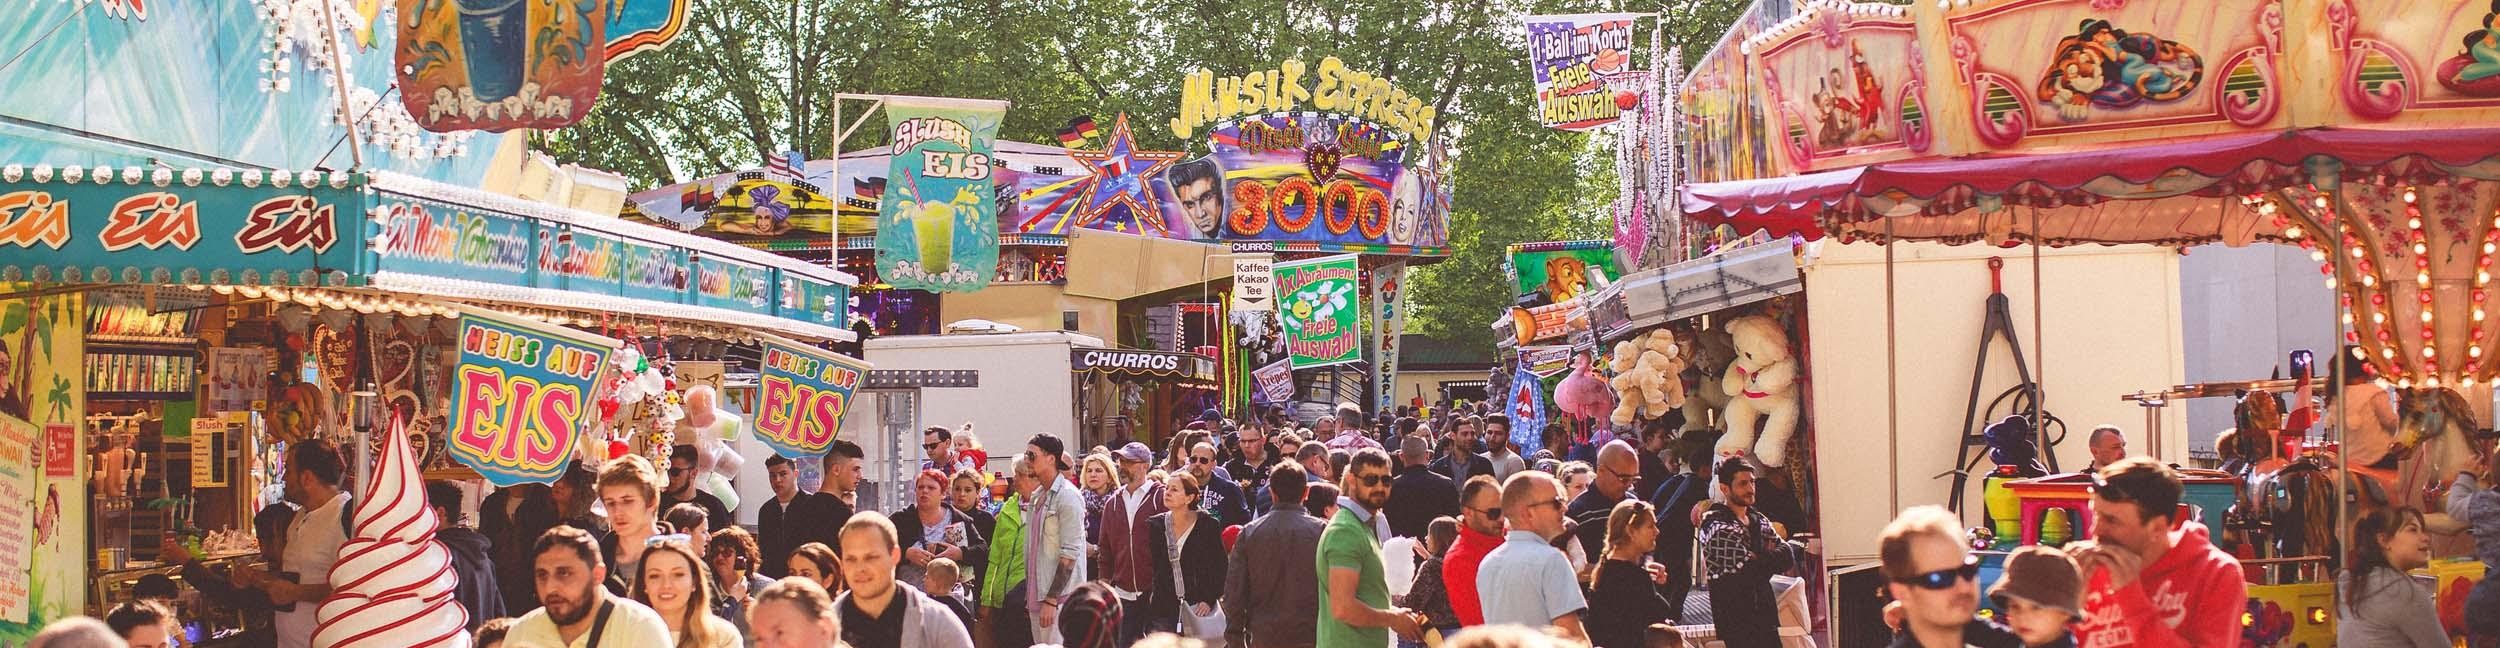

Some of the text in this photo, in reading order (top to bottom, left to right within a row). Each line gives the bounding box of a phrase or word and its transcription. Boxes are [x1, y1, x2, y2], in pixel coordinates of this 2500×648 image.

[1544, 28, 1570, 60] Ball
[1572, 30, 1591, 54] im
[1592, 23, 1627, 51] Korb:
[1548, 58, 1590, 94] Freie
[1170, 56, 1435, 142] MUSIK EXPRESS
[893, 116, 972, 156] SLUSH
[921, 149, 991, 181] EIS
[0, 191, 70, 250] Eis
[98, 192, 201, 251] Eis
[234, 195, 338, 253] Eis
[1229, 176, 1391, 240] 3000
[1232, 242, 1273, 252] CHURROS
[1236, 263, 1269, 273] Kaffee
[1237, 274, 1268, 284] Kakao
[1276, 273, 1296, 299] 1x
[1245, 286, 1262, 295] Tee
[1290, 323, 1357, 360] Auswahl
[1302, 315, 1338, 338] Freie
[465, 325, 600, 381] HEISS AUF
[767, 348, 857, 389] HEISS AUF
[1084, 351, 1178, 370] CHURROS
[196, 420, 223, 430] Slush
[454, 366, 580, 469] EIS
[756, 375, 843, 449] EIS
